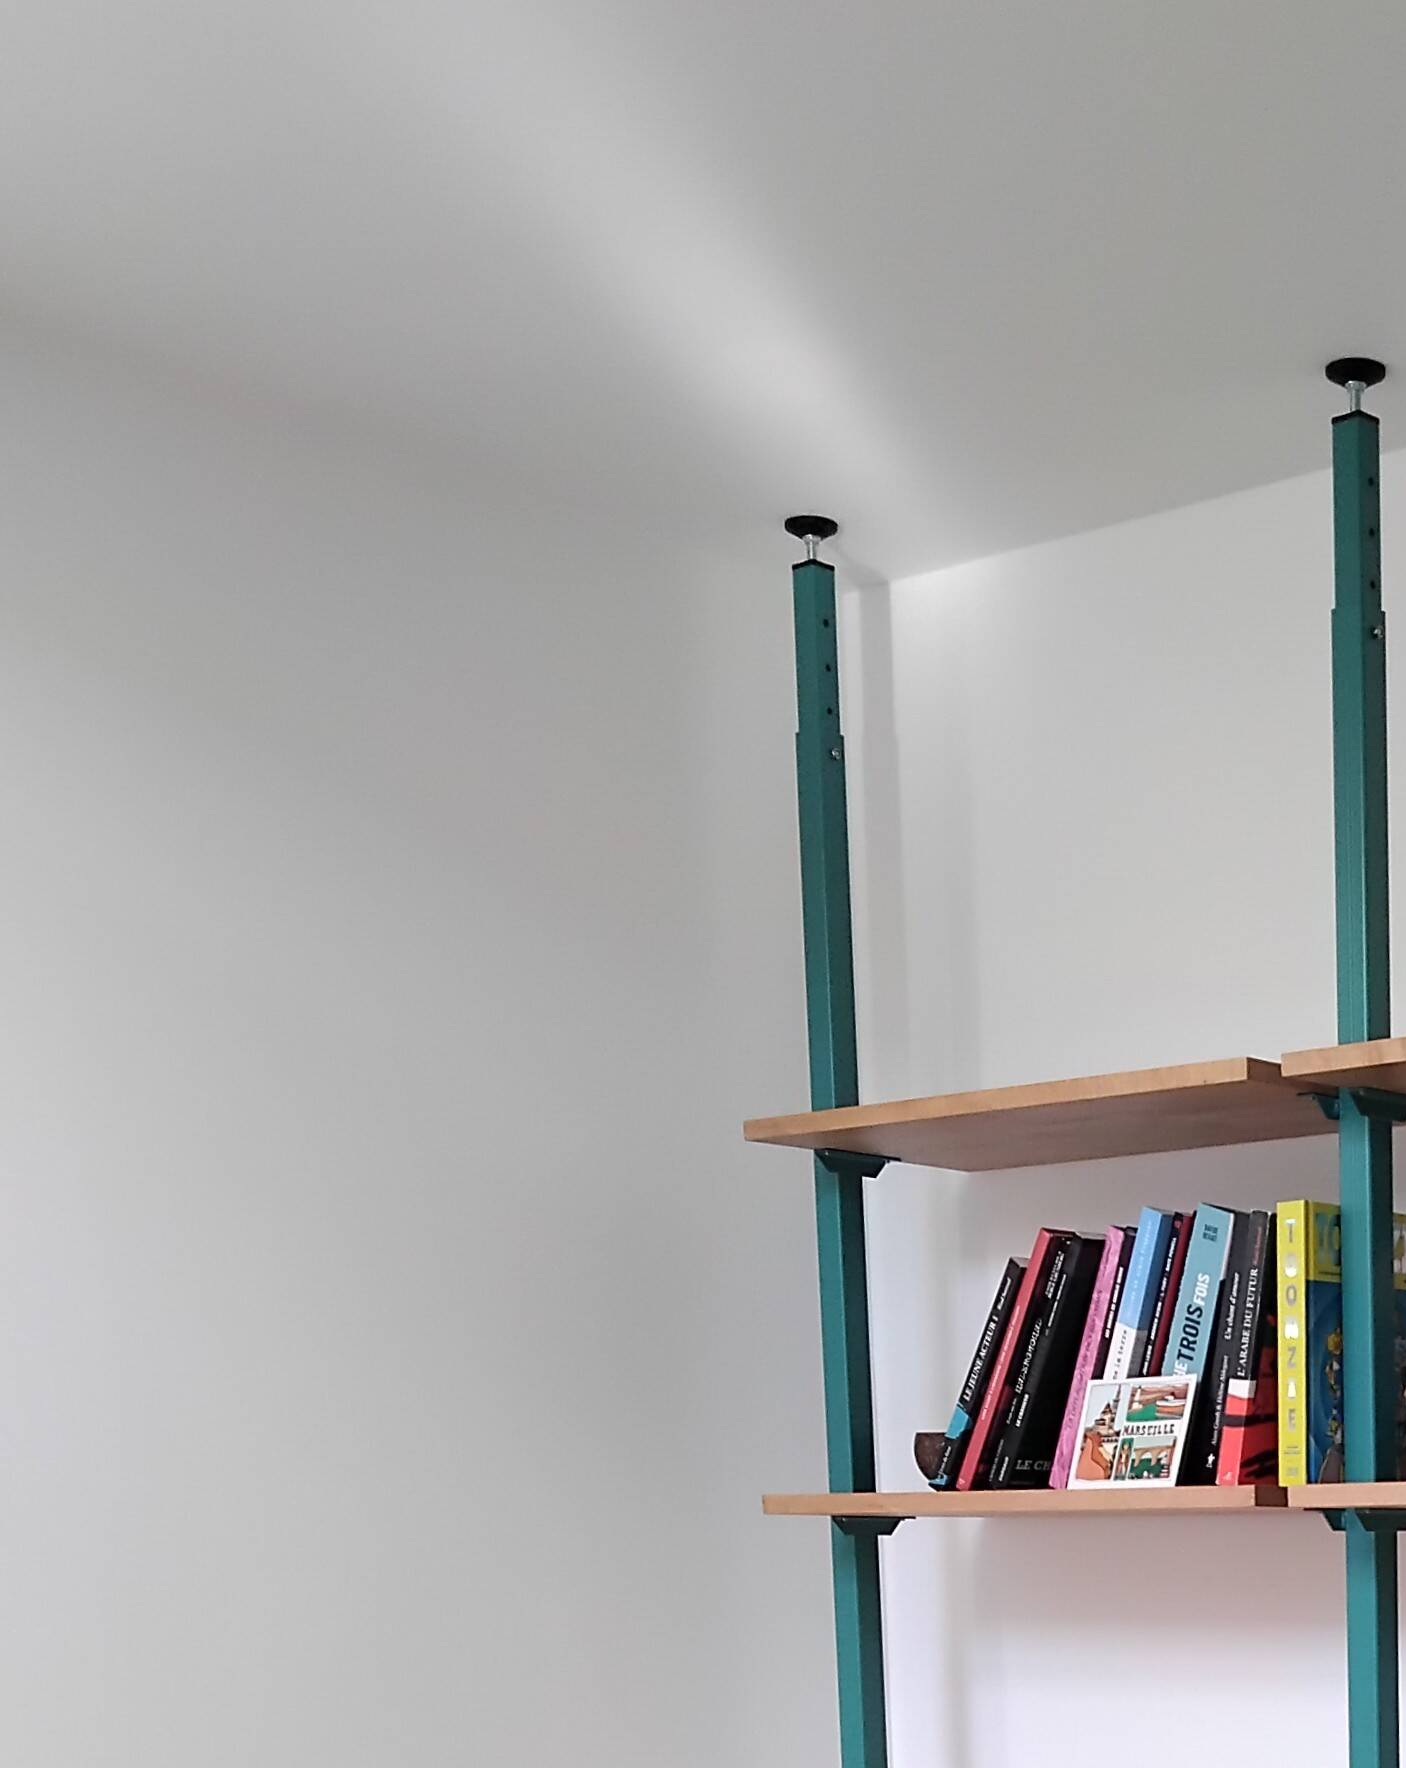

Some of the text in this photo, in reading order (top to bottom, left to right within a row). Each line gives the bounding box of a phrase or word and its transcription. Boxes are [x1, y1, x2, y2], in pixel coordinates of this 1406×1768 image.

[1245, 1268, 1258, 1307] FUTUR
[1177, 1303, 1203, 1363] TROIS
[1191, 1271, 1211, 1305] FOIS
[1225, 1304, 1236, 1326] chant
[1243, 1309, 1252, 1327] DU
[977, 1321, 996, 1359] ACTEUR
[1223, 1326, 1232, 1339] Un
[966, 1356, 984, 1388] JEUNE
[961, 1386, 973, 1401] LE
[1122, 1424, 1175, 1436] MARSEILLE
[1016, 1460, 1050, 1470] LE CH
